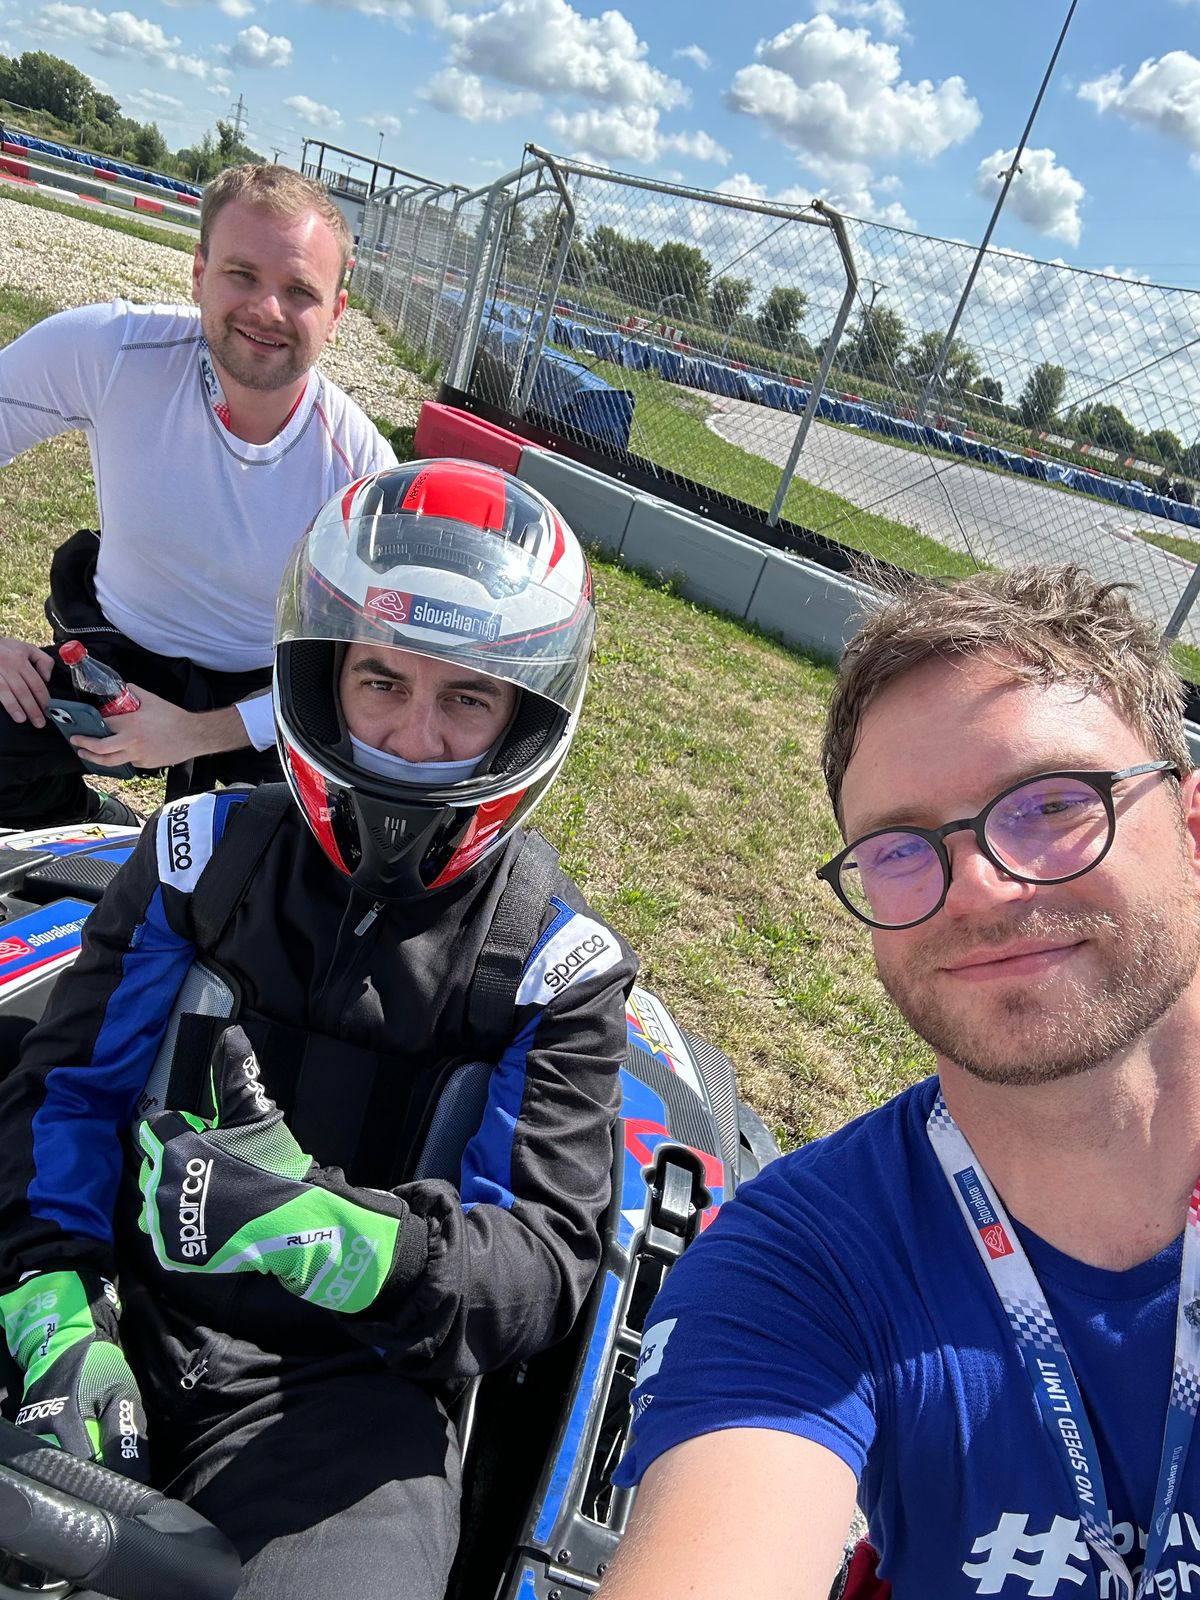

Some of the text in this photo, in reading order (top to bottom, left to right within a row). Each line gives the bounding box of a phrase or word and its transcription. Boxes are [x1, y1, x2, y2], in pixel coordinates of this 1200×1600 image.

[413, 602, 497, 641] slovakiaring
[167, 803, 193, 872] sparco
[543, 933, 607, 992] sparco
[179, 1157, 210, 1257] sparco
[961, 1169, 994, 1225] slovakiaring
[287, 1230, 333, 1246] RUSH
[119, 1400, 139, 1459] sparco
[1036, 1358, 1096, 1506] NO SPEED LIMIT
